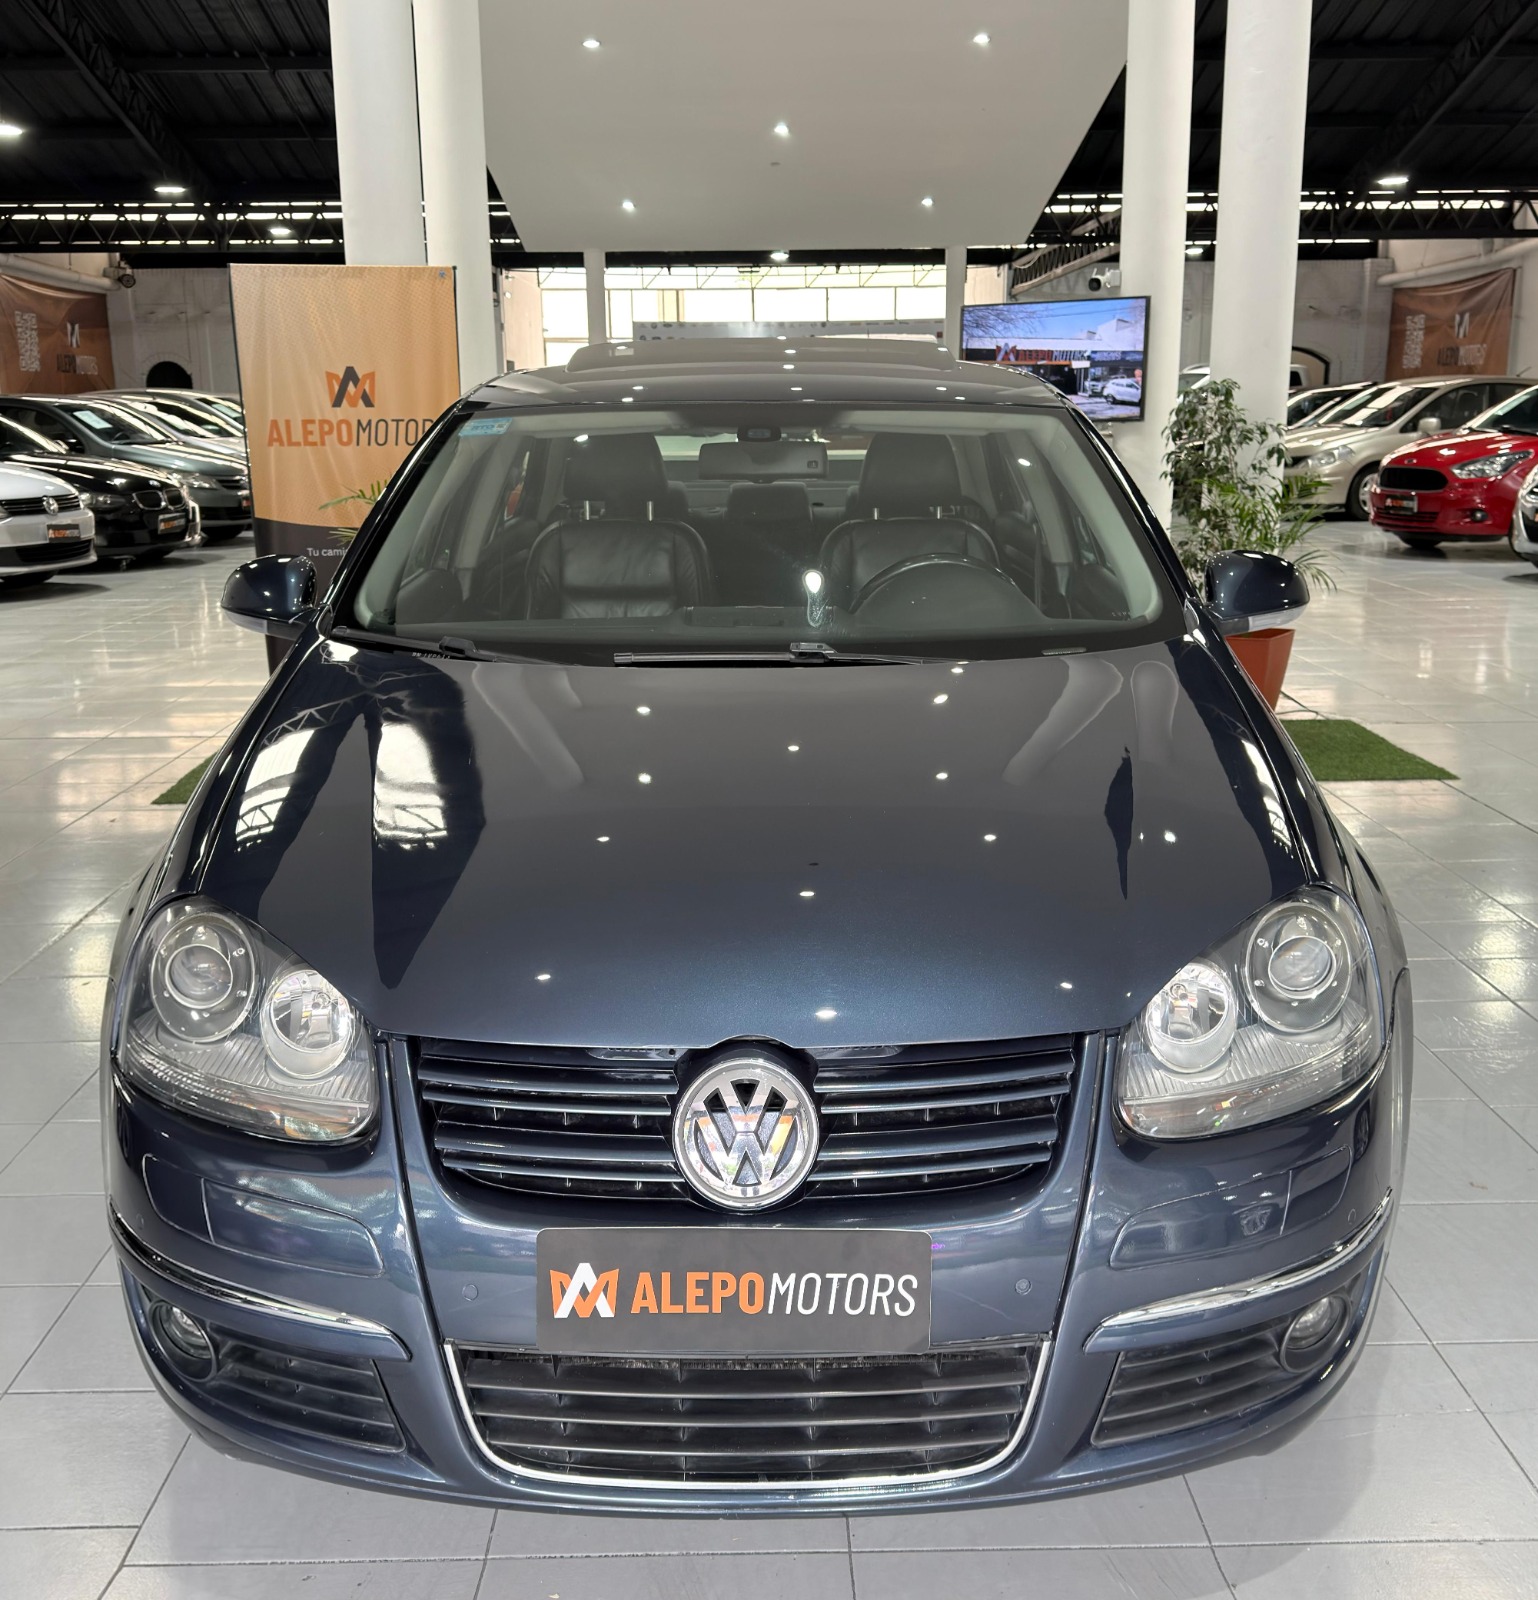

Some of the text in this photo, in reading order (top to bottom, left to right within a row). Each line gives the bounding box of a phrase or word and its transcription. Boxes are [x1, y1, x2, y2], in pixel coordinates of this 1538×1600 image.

[306, 547, 347, 557] Tu cami
[630, 1271, 918, 1317] ALEPOMOTORS
